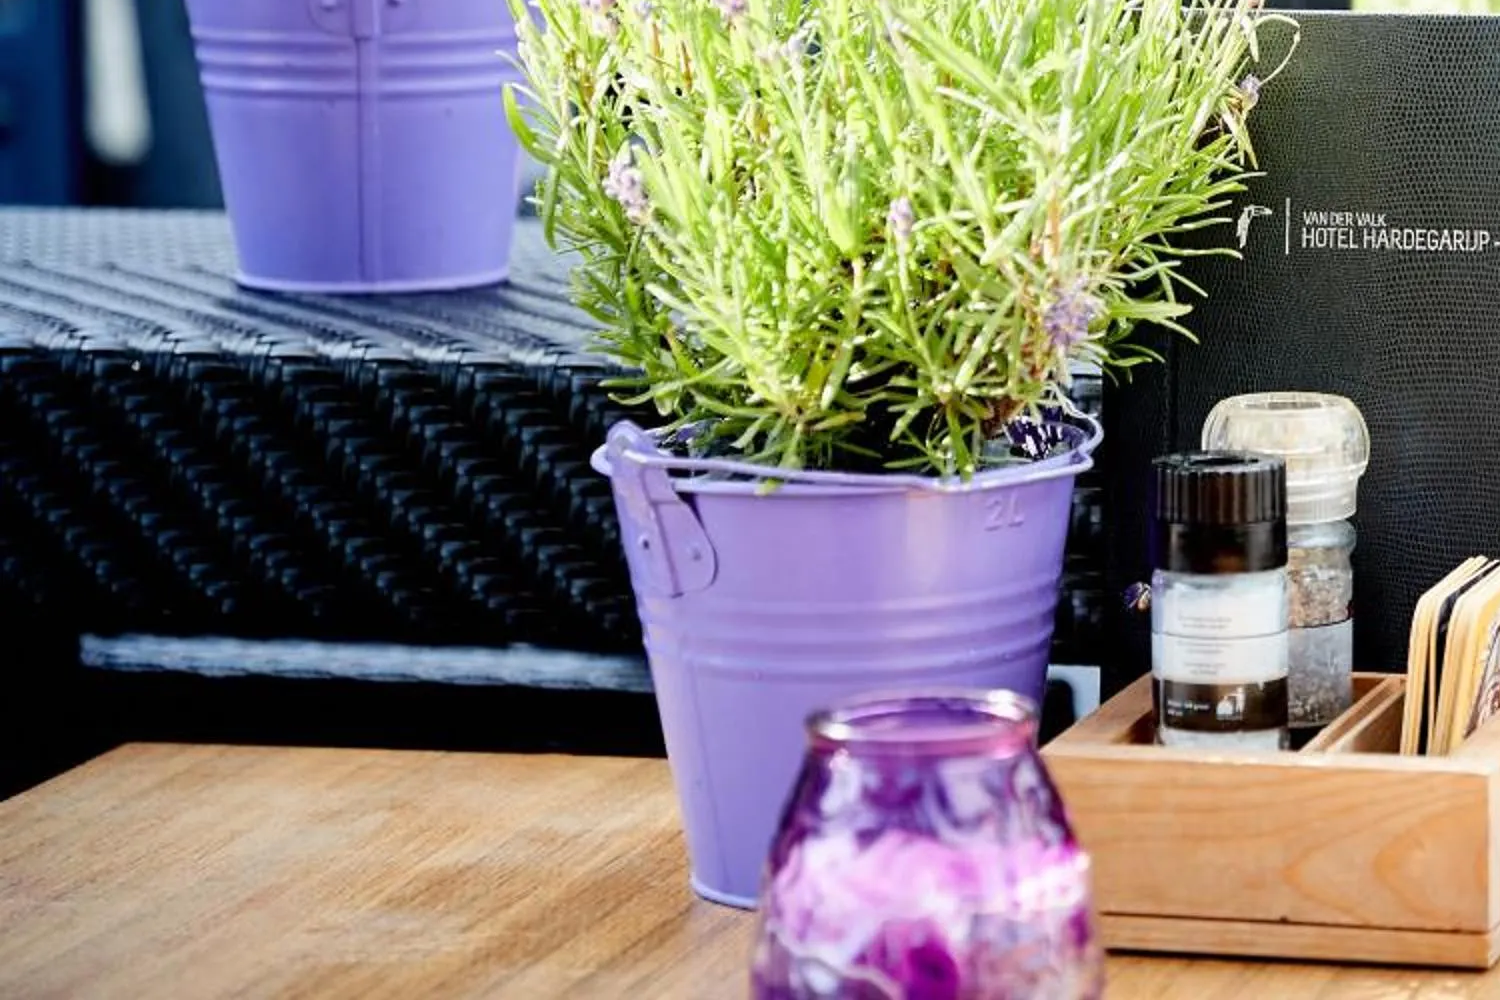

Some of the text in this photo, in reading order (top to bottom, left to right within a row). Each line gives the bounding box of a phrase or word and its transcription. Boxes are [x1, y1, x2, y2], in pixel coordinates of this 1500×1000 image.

[1303, 212, 1387, 227] VAN DER VALK
[1302, 227, 1359, 249] HOTEL
[1363, 228, 1491, 251] HARDEGARIJP
